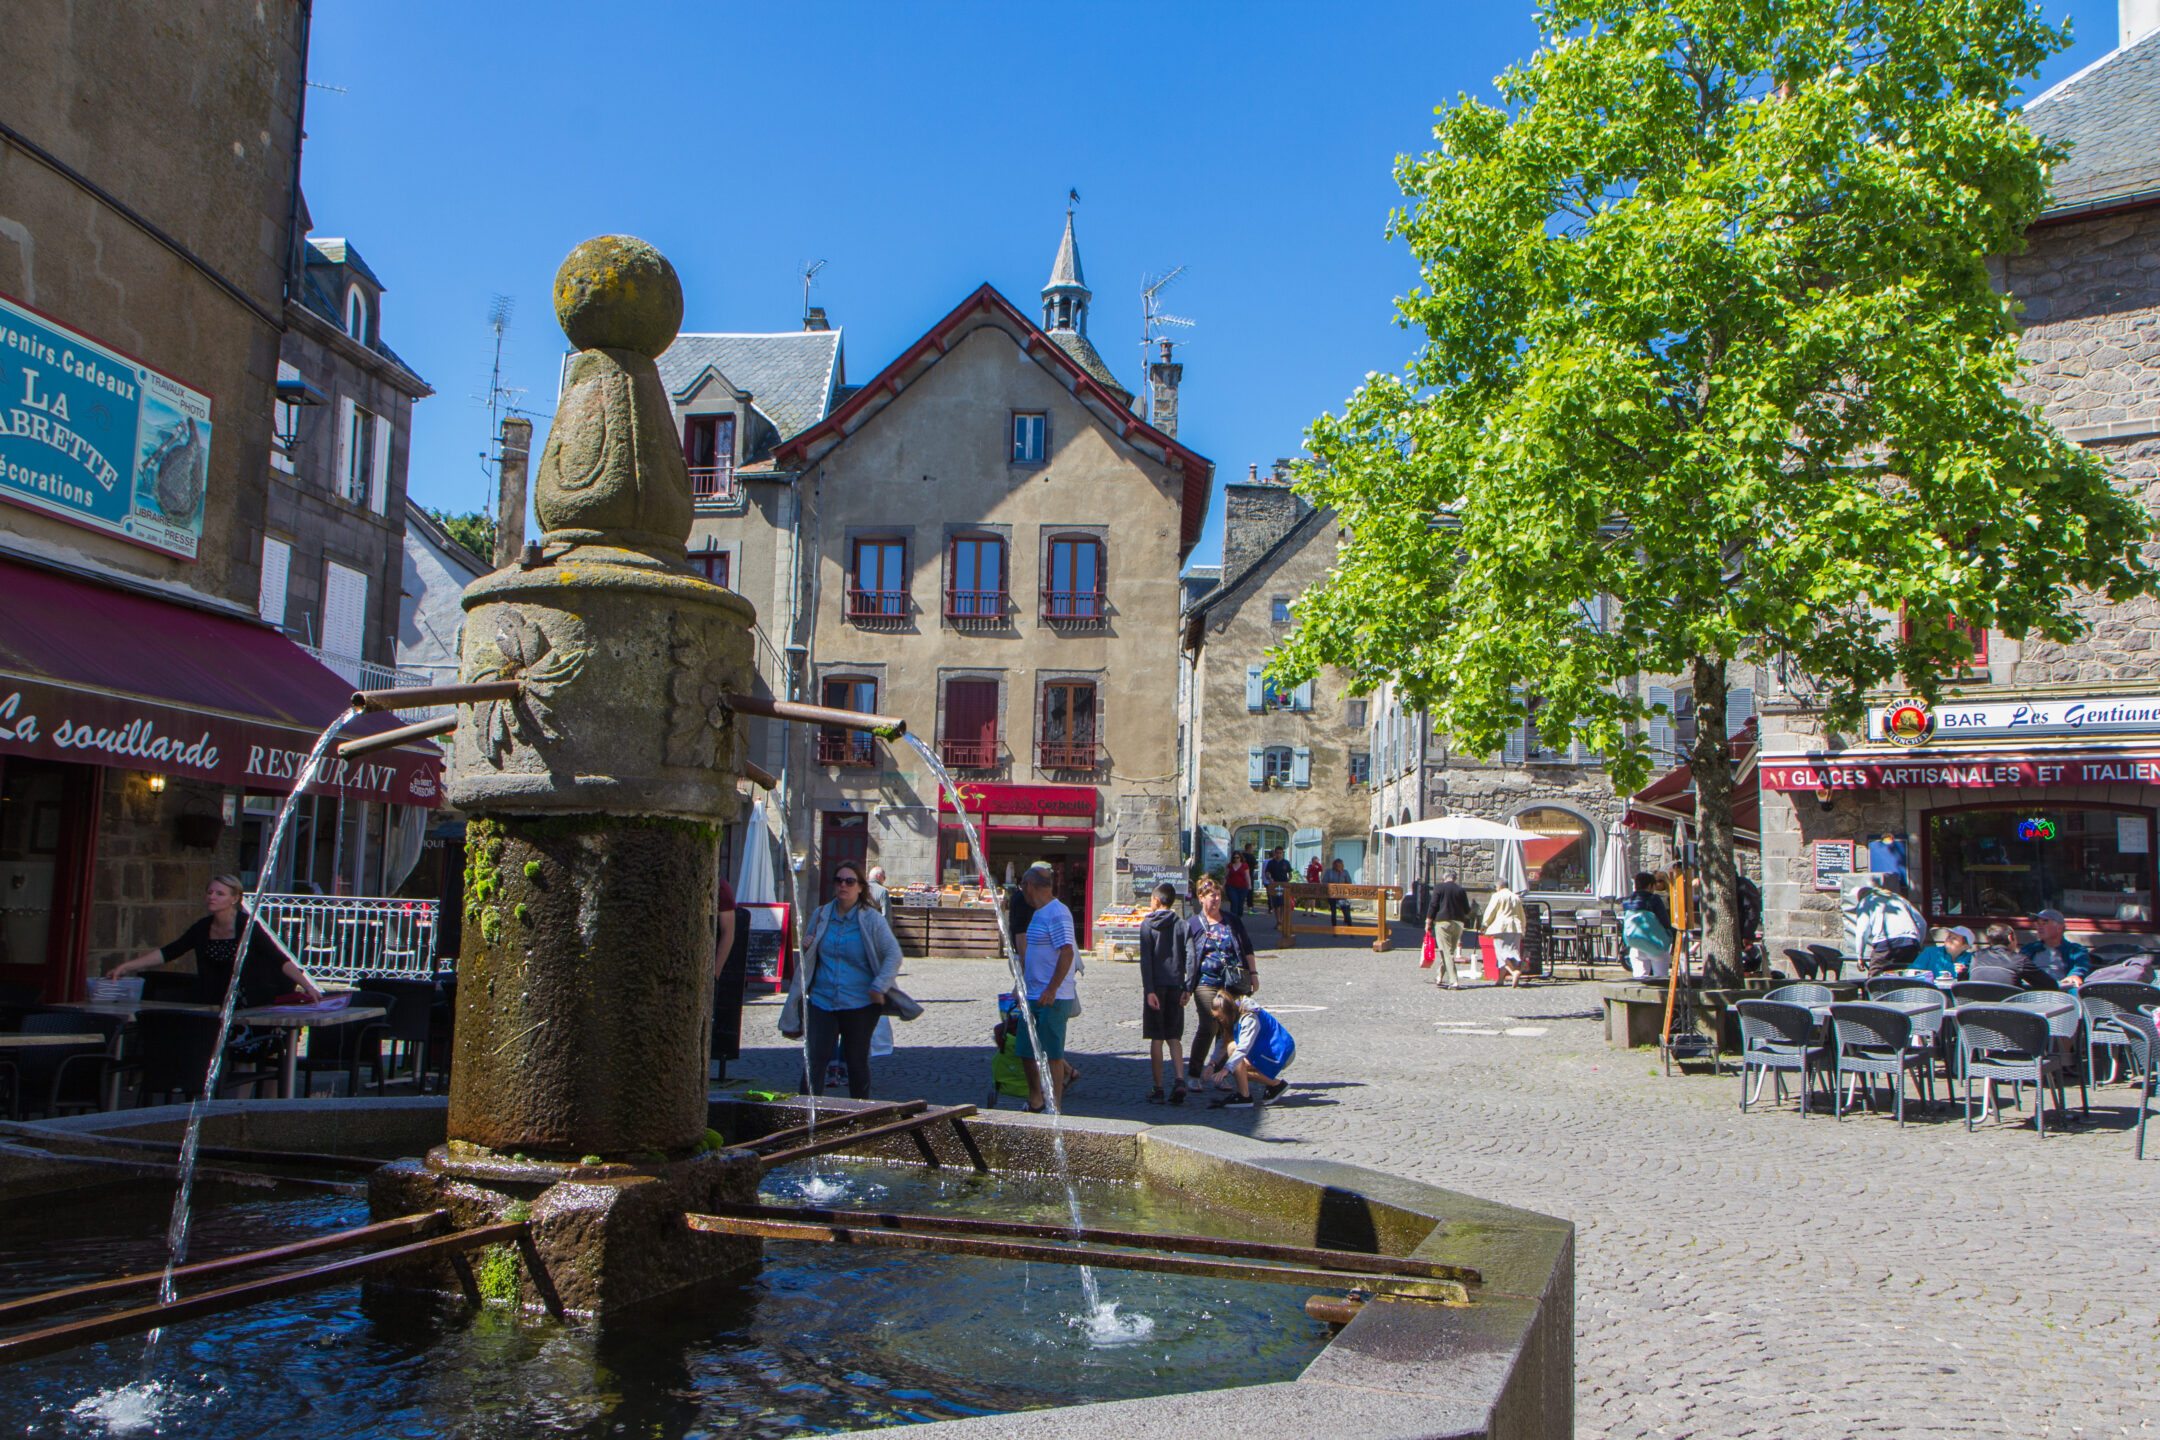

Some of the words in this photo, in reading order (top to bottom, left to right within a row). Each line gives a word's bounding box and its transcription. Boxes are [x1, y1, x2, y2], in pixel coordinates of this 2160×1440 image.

[21, 367, 71, 421] LA
[151, 375, 185, 398] TRAVAUX
[180, 400, 206, 419] PHOTO
[134, 506, 172, 527] LIBRAIRIE
[165, 529, 196, 548] PRESSE
[1883, 698, 1934, 718] PAULANR
[1945, 713, 1987, 727] BAR
[2008, 706, 2049, 728] Les
[52, 718, 220, 769] souillarde
[244, 745, 397, 793] RESTURANT
[1791, 770, 1867, 786] GLACES
[1881, 766, 2021, 785] ARTISANALES
[2038, 765, 2065, 782] ET
[2083, 763, 2160, 781] ITALIEN
[2025, 829, 2050, 838] BAR
